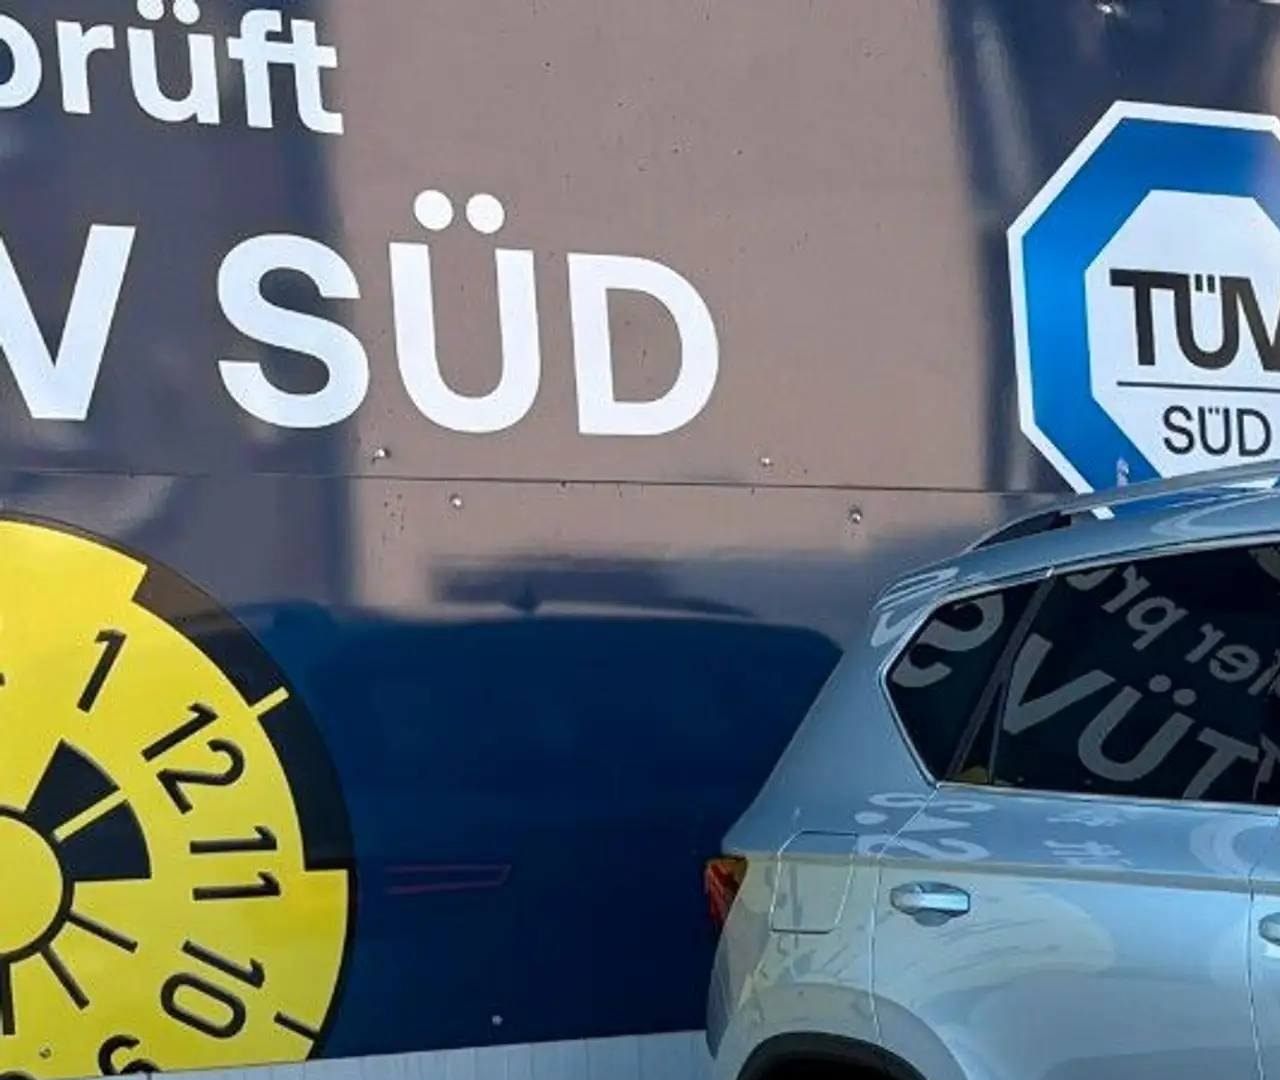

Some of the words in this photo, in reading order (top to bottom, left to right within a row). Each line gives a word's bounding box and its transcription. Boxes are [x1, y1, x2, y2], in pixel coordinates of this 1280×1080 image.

[217, 190, 719, 435] SÜD
[1162, 405, 1272, 458] SÜD
[77, 630, 126, 712] 1
[141, 702, 246, 814] 12
[189, 825, 282, 901] 11
[160, 940, 265, 1039] 10
